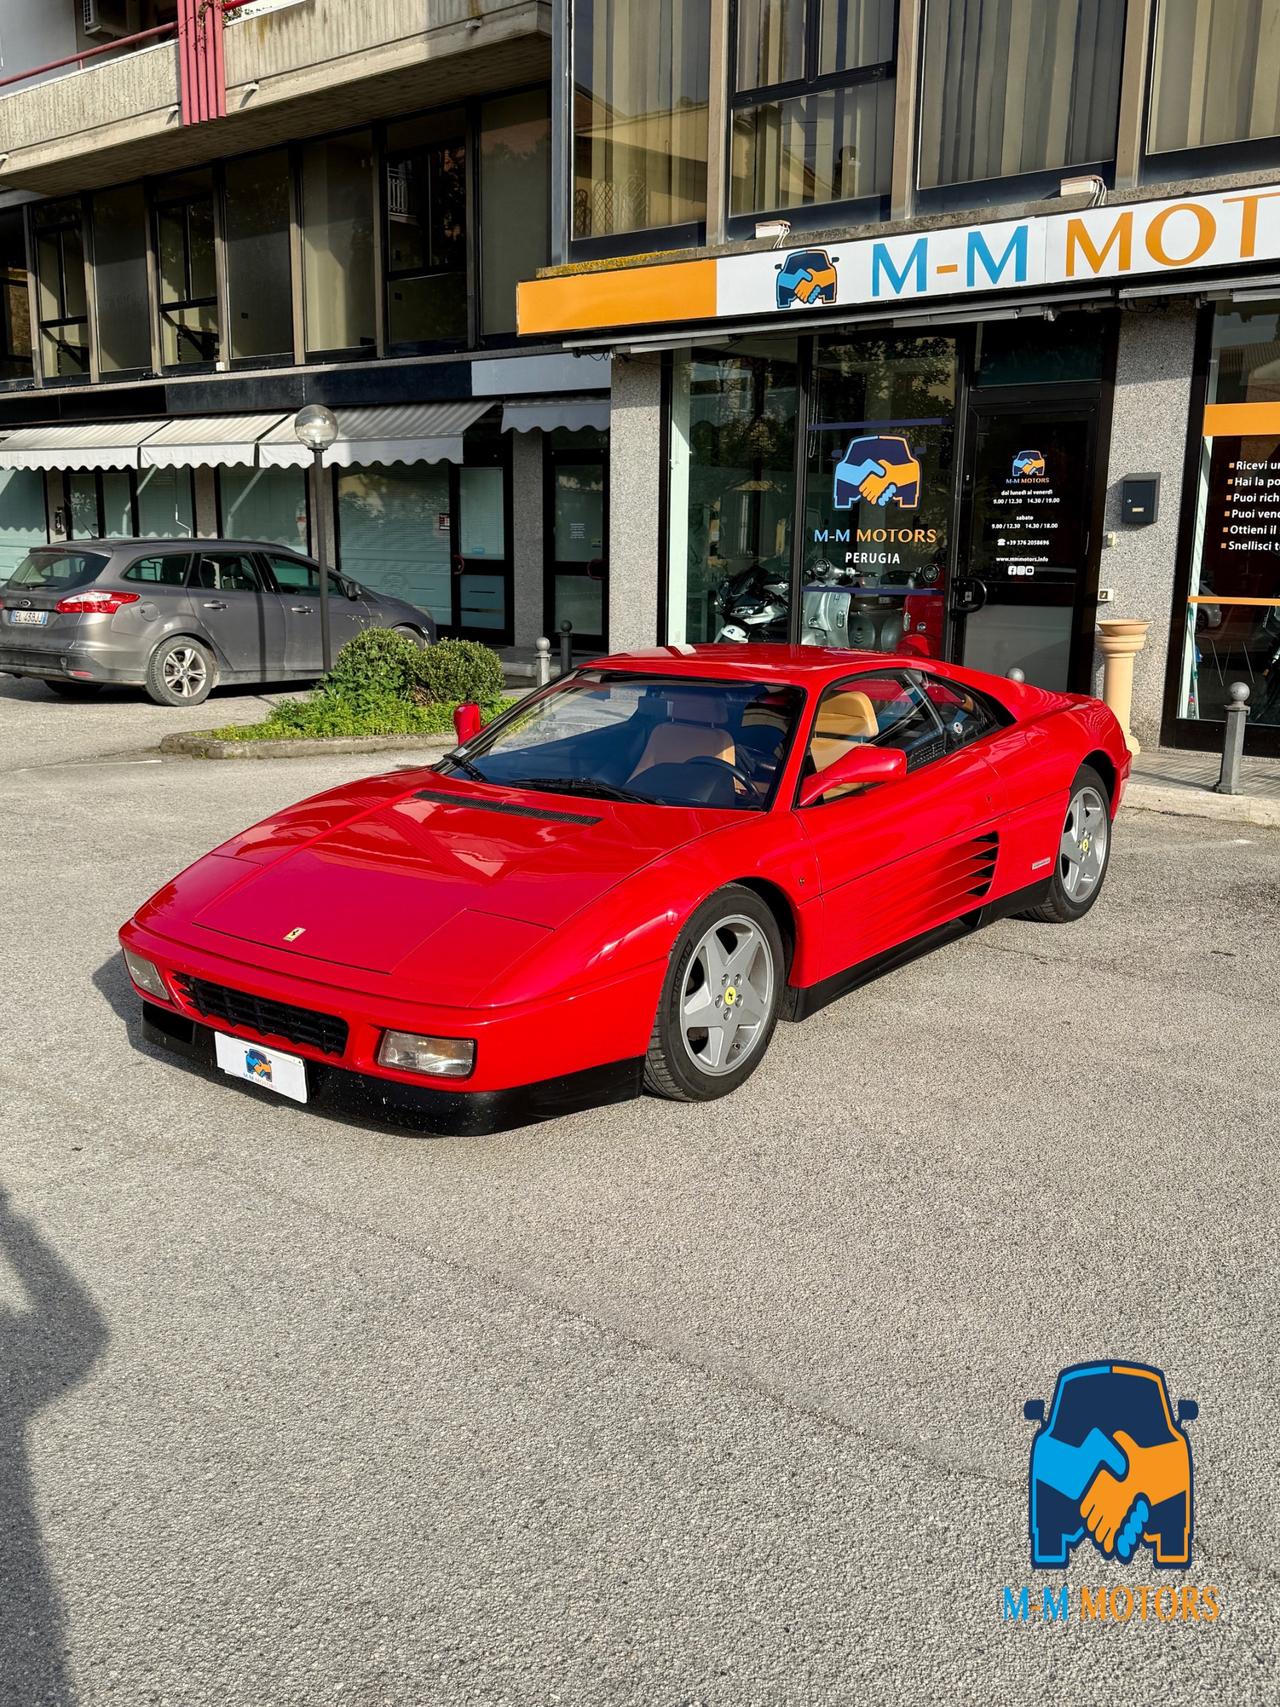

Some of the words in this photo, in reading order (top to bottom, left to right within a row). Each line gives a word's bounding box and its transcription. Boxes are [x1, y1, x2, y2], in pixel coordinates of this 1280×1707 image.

[872, 225, 1028, 297] M-M
[1066, 192, 1280, 277] MOT
[1236, 461, 1268, 471] Ricevi
[1234, 477, 1252, 487] Hai
[1255, 476, 1264, 486] la
[1233, 493, 1257, 503] Puoi
[1259, 492, 1280, 503] rich
[1231, 509, 1256, 519] Puoi
[1229, 525, 1268, 535] Ottieni
[1269, 525, 1278, 535] il
[814, 529, 851, 543] M-M
[856, 529, 937, 543] MOTORS
[1228, 541, 1272, 551] Snellisci
[845, 552, 901, 564] PERUGIA
